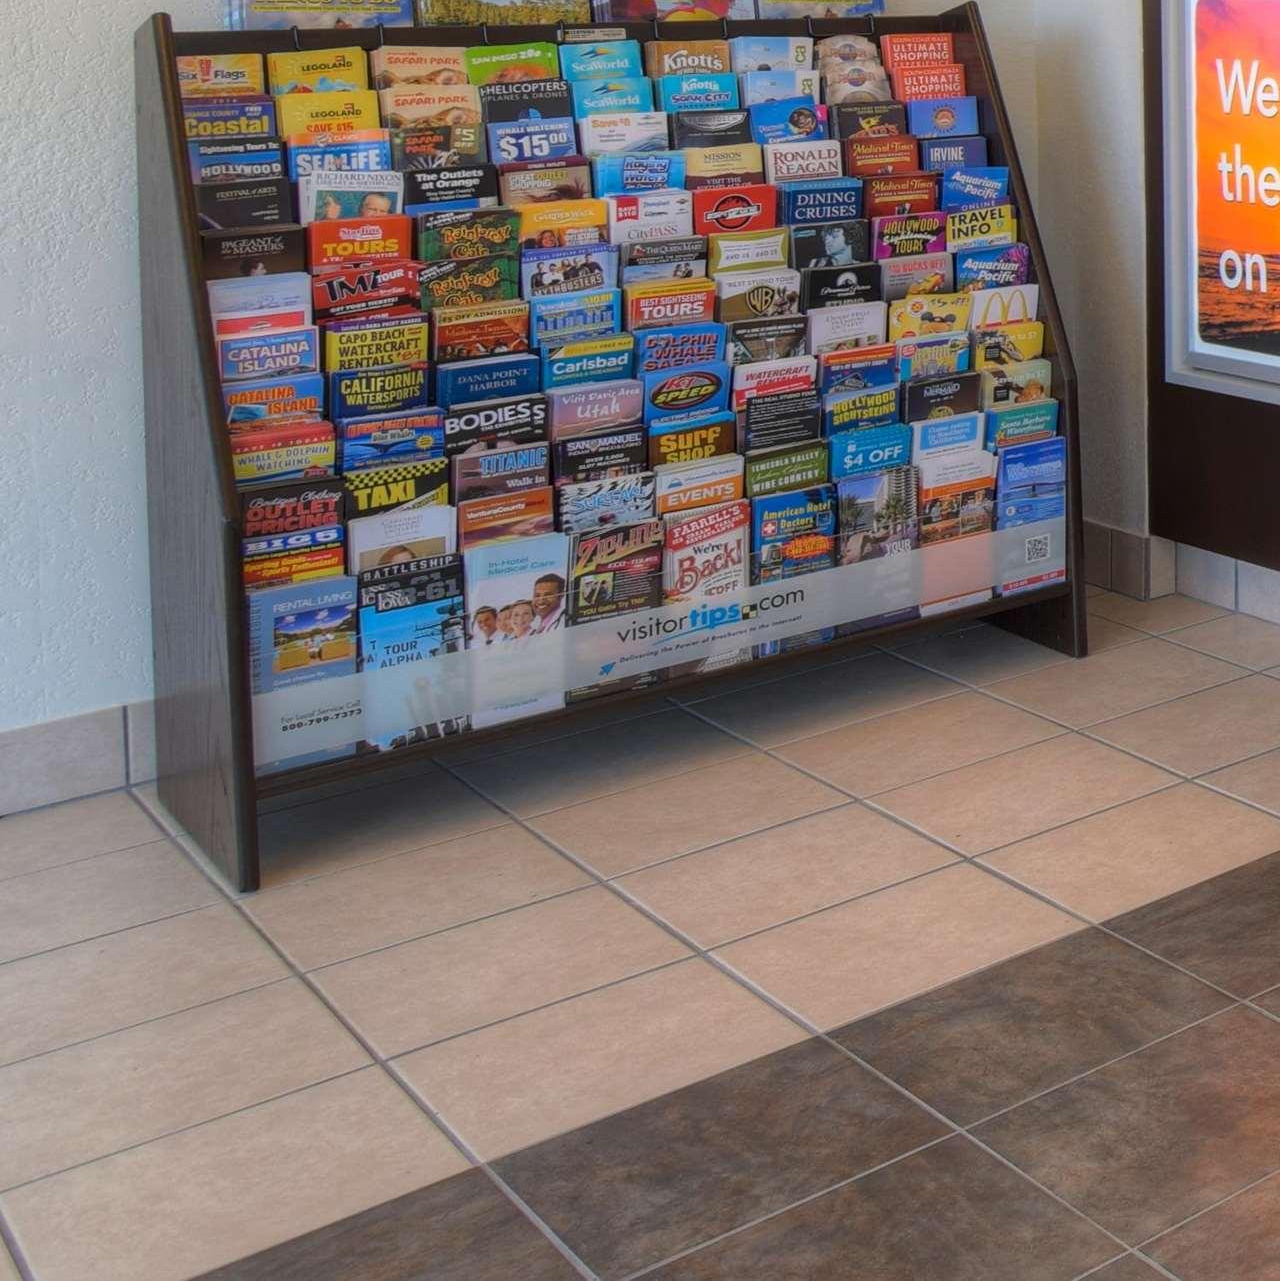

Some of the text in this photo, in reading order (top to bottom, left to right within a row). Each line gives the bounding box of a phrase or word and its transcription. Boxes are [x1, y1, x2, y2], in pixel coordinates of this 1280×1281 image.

[893, 43, 949, 52] ULTIMATE
[387, 56, 460, 66] SAFARI PARK
[664, 50, 723, 72] Knott's
[893, 51, 949, 61] SHOPPING
[301, 60, 352, 72] LEGOLAND
[571, 59, 629, 72] SeaWorld
[178, 69, 246, 81] Six Flags
[904, 75, 960, 85] ULTIMATE
[486, 80, 567, 95] HELICOPTERS
[904, 83, 961, 94] SHOPPING
[394, 95, 468, 107] SAFARI PARK
[584, 95, 640, 108] SeaWorld
[310, 108, 362, 118] LEGOLAND
[185, 116, 269, 136] Coastal
[307, 122, 333, 133] SAVE
[497, 123, 568, 134] WHALE WATCHING
[246, 143, 266, 152] Tours
[703, 151, 741, 160] MISSION
[930, 146, 965, 161] IRVINE
[297, 150, 333, 175] SEA
[774, 149, 837, 163] RONALD
[200, 164, 281, 177] HOLLYWOOD
[415, 169, 484, 182] The Outlets
[775, 161, 838, 175] REAGAN
[316, 173, 400, 182] RICHARD NIXON
[421, 178, 480, 189] at Orange
[951, 171, 1001, 189] Aquarium
[797, 191, 856, 205] DINING
[964, 184, 998, 199] Pacific
[795, 204, 856, 219] CRUISES
[961, 201, 995, 210] ONLINE
[950, 206, 1005, 226] TRAVEL
[442, 224, 511, 245] Rainforest
[884, 219, 939, 234] HOLLYWOOD
[952, 223, 991, 239] INFO
[221, 237, 272, 248] PAGEANT
[233, 243, 284, 254] MASTERS
[322, 239, 399, 256] TOURS
[895, 241, 924, 254] TOURS
[962, 258, 1019, 271] Aquarium
[1219, 248, 1268, 293] on
[430, 267, 500, 297] Rainforest
[977, 269, 1016, 283] Pacific
[317, 270, 381, 303] TMZ
[377, 269, 404, 283] TOUR
[640, 292, 707, 307] BEST SIGHTSEEING
[640, 302, 704, 318] TOURS
[339, 328, 405, 344] CAPO BEACH
[228, 341, 309, 361] CATALINA
[339, 338, 420, 357] WATERCRAFT
[654, 345, 717, 359] WHALE
[239, 355, 301, 373] ISLAND
[339, 355, 394, 370] RENTALS
[553, 354, 629, 374] Carlsbad
[457, 368, 529, 384] DANA POINT
[745, 365, 809, 382] WATERCRAFT
[341, 375, 425, 394] CALIFORNIA
[469, 379, 517, 392] HARBOR
[228, 386, 295, 406] CATALINA
[346, 386, 420, 406] WATERSPORTS
[655, 384, 717, 404] SPEED
[268, 398, 317, 414] ISLAND
[577, 398, 621, 419] Utah
[832, 391, 896, 414] HOLLYWOOD
[446, 403, 531, 434] BODIES
[833, 402, 896, 425] SIGHTSEEING
[567, 434, 641, 451] SAN MANUEL
[237, 454, 272, 465] WHALE
[285, 446, 329, 457] DOLPHIN
[479, 447, 547, 475] TITANIC
[665, 445, 716, 463] SHOP
[751, 451, 820, 472] TEMECULA VALLEY
[843, 447, 904, 470] $4 OFF
[256, 457, 311, 471] WATCHING
[506, 478, 532, 488] Walk
[752, 469, 819, 492] WINE COUNTRY
[353, 479, 415, 511] TAXI
[668, 484, 736, 506] EVENTS
[246, 498, 336, 519] OUTLET
[763, 501, 831, 521] American Hotel
[246, 513, 337, 535] PRICING
[673, 504, 742, 538] FARRELL'S
[781, 516, 814, 529] Doctors
[247, 529, 337, 552] BIG 5
[693, 543, 723, 555] We're
[363, 556, 454, 582] BATTLESHIP
[488, 556, 529, 567] In-Hotel
[488, 559, 554, 575] Medical Care
[676, 539, 742, 594] Back!
[273, 591, 352, 613] RENTAL LIVING
[383, 641, 418, 655] TOUR
[620, 650, 660, 663] Delivering
[661, 646, 674, 654] the
[676, 640, 700, 651] Power
[712, 629, 748, 643] Brochures
[380, 652, 423, 669] ALPHA
[298, 710, 315, 721] Local
[317, 705, 344, 716] Service
